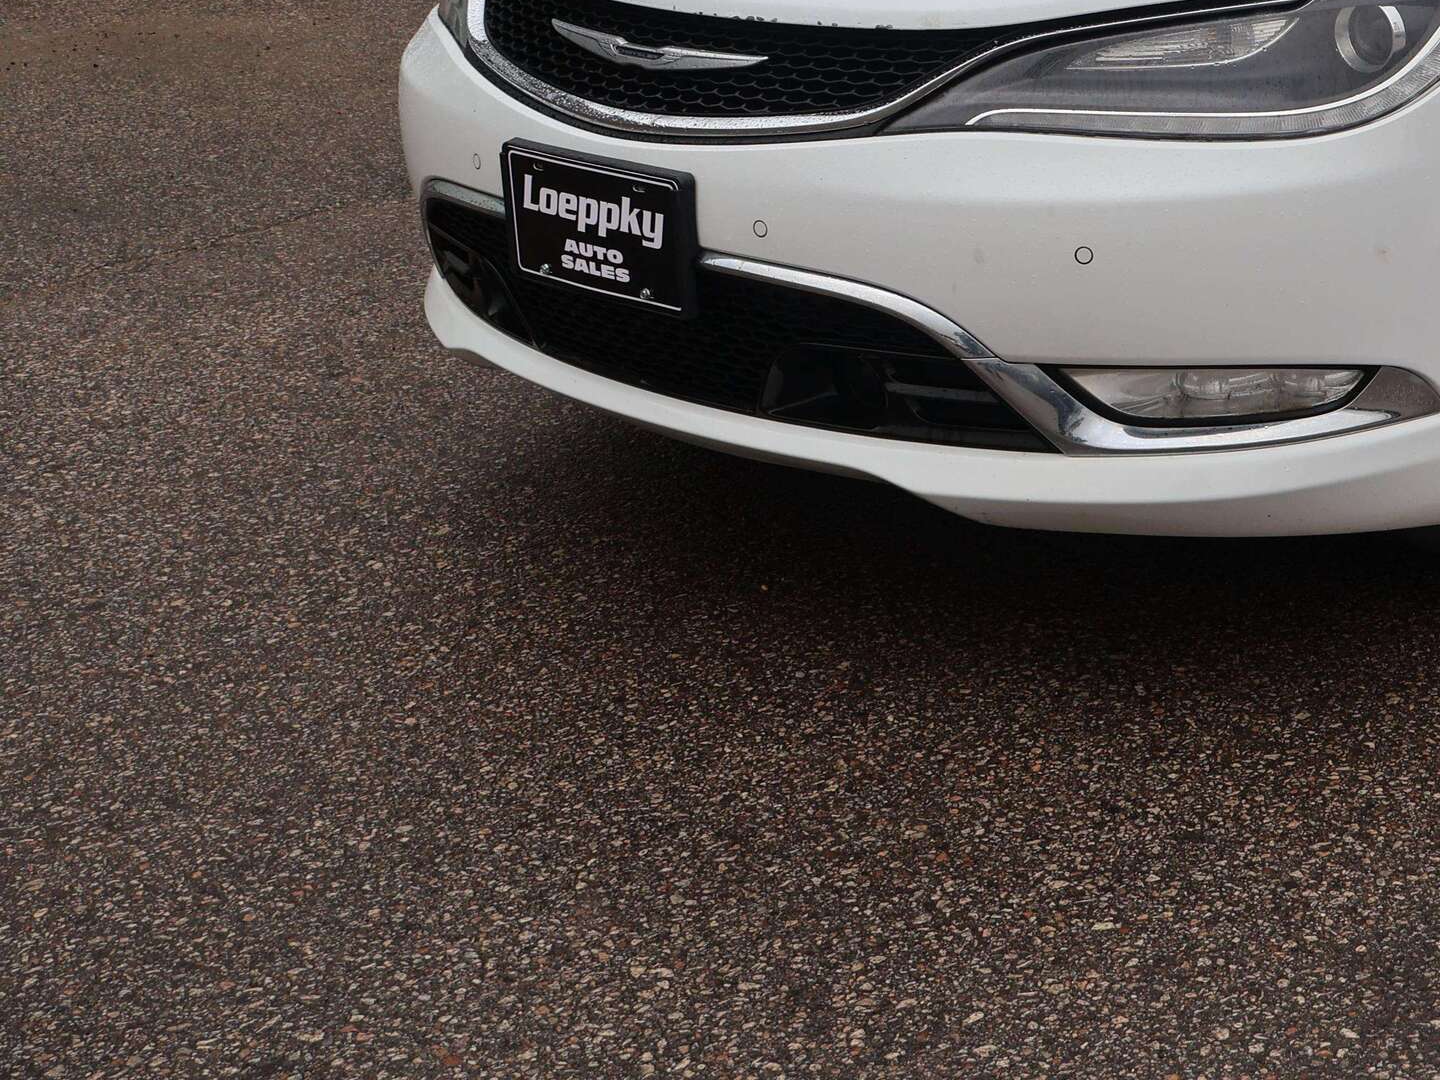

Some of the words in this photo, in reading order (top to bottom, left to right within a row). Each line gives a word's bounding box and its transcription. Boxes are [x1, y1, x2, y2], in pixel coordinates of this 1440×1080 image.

[522, 173, 665, 251] Loeppky
[563, 238, 624, 265] AUTO
[560, 254, 631, 283] SALES
